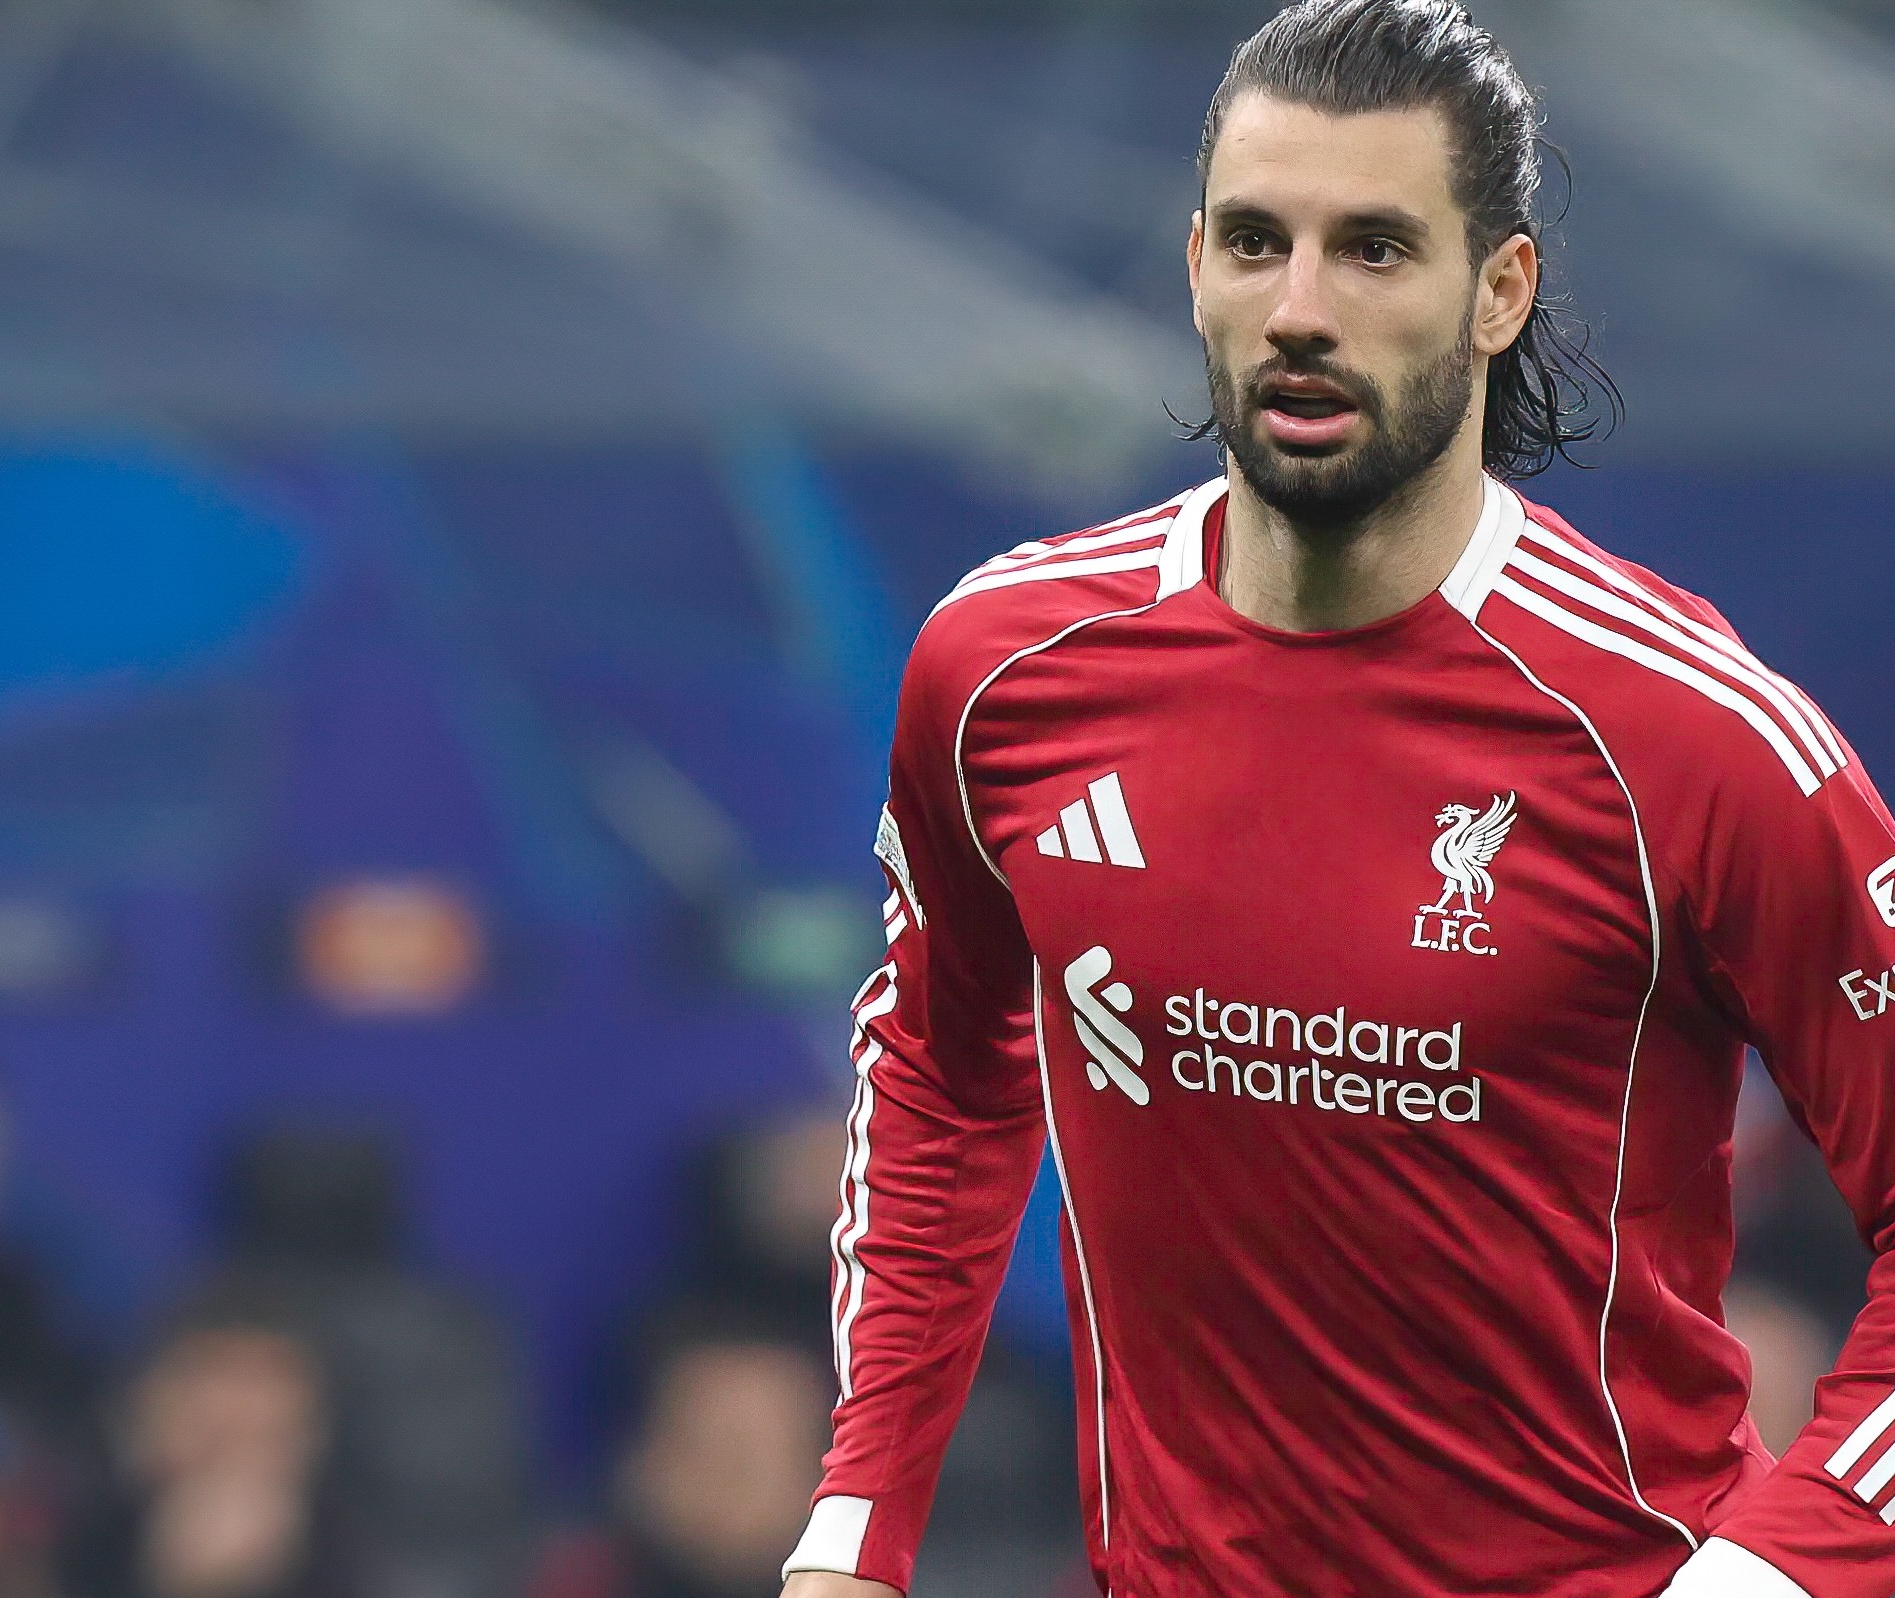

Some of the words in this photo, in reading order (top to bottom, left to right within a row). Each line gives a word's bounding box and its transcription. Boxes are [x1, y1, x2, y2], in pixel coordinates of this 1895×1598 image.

[1411, 914, 1499, 956] L.F.C.
[1165, 988, 1461, 1071] standard
[1171, 1044, 1481, 1122] chartered
